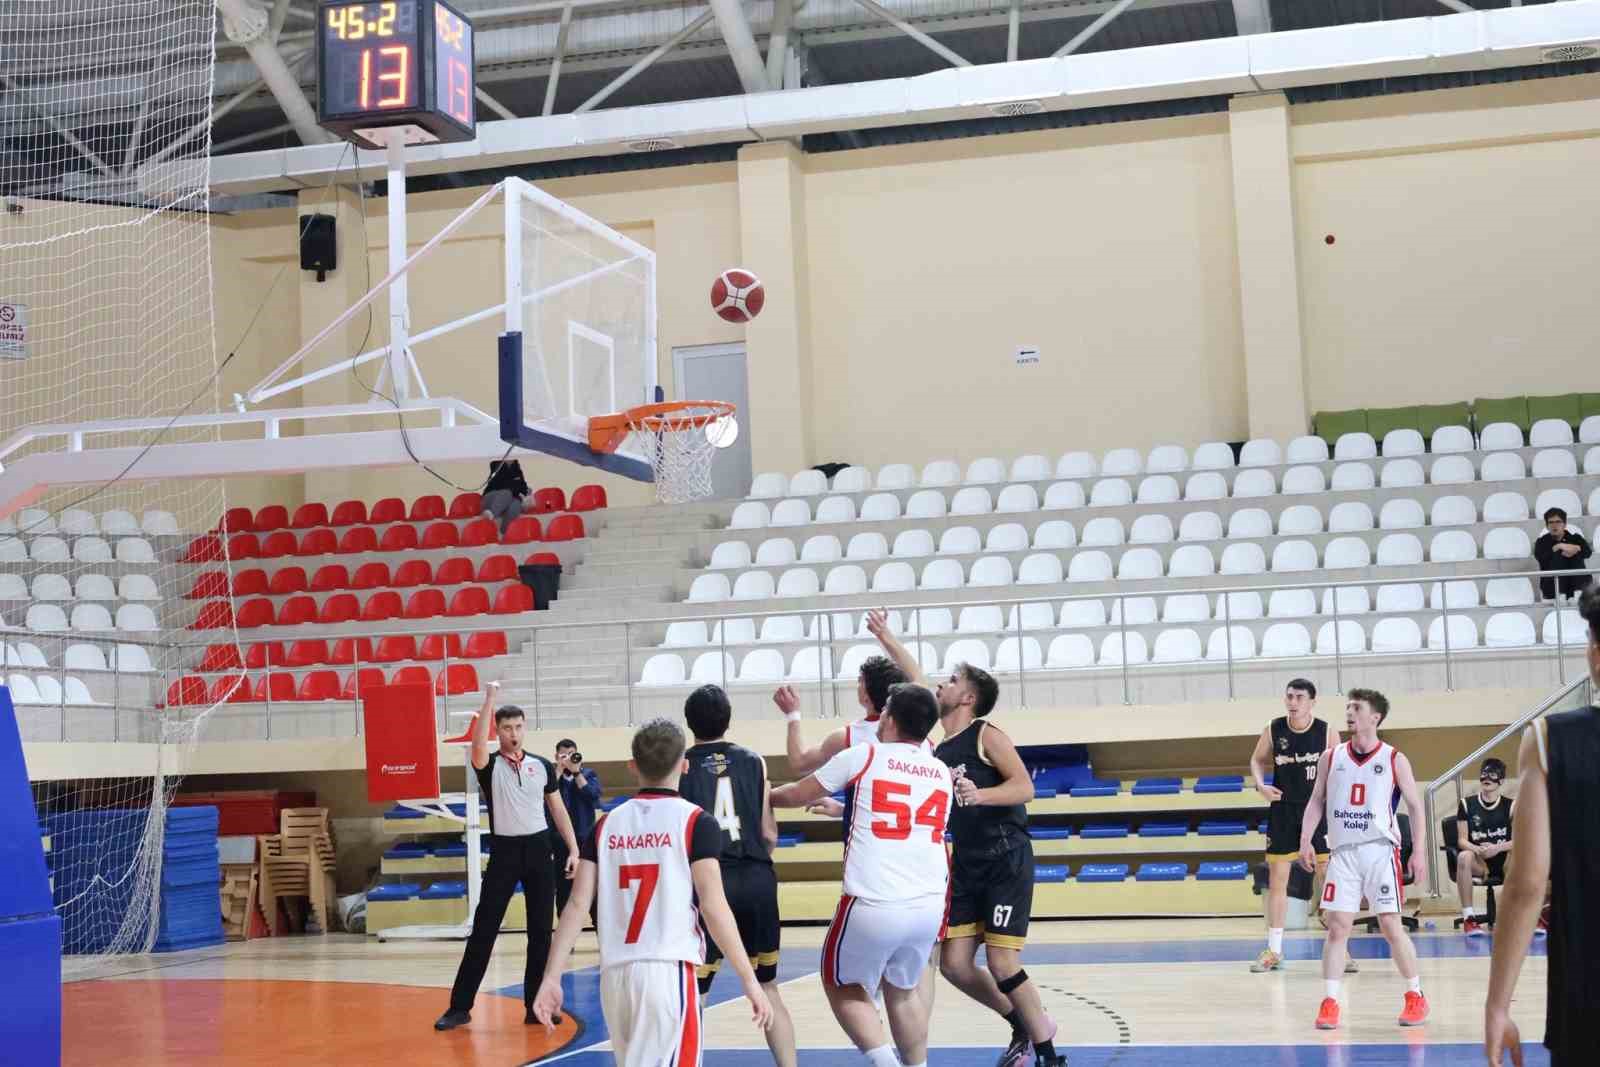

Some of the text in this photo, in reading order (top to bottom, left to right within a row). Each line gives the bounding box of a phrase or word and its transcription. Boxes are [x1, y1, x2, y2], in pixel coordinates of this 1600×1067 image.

[328, 3, 397, 40] 45.2
[360, 45, 410, 110] 13
[887, 757, 944, 781] SAKARYA
[1305, 764, 1316, 780] 10
[1350, 783, 1366, 806] 0
[713, 776, 741, 842] 4
[871, 778, 949, 845] 54
[1343, 819, 1369, 832] Koleji
[607, 831, 673, 851] SAKARYA
[618, 862, 661, 945] 7
[1323, 882, 1336, 902] 0
[992, 904, 1013, 928] 67
